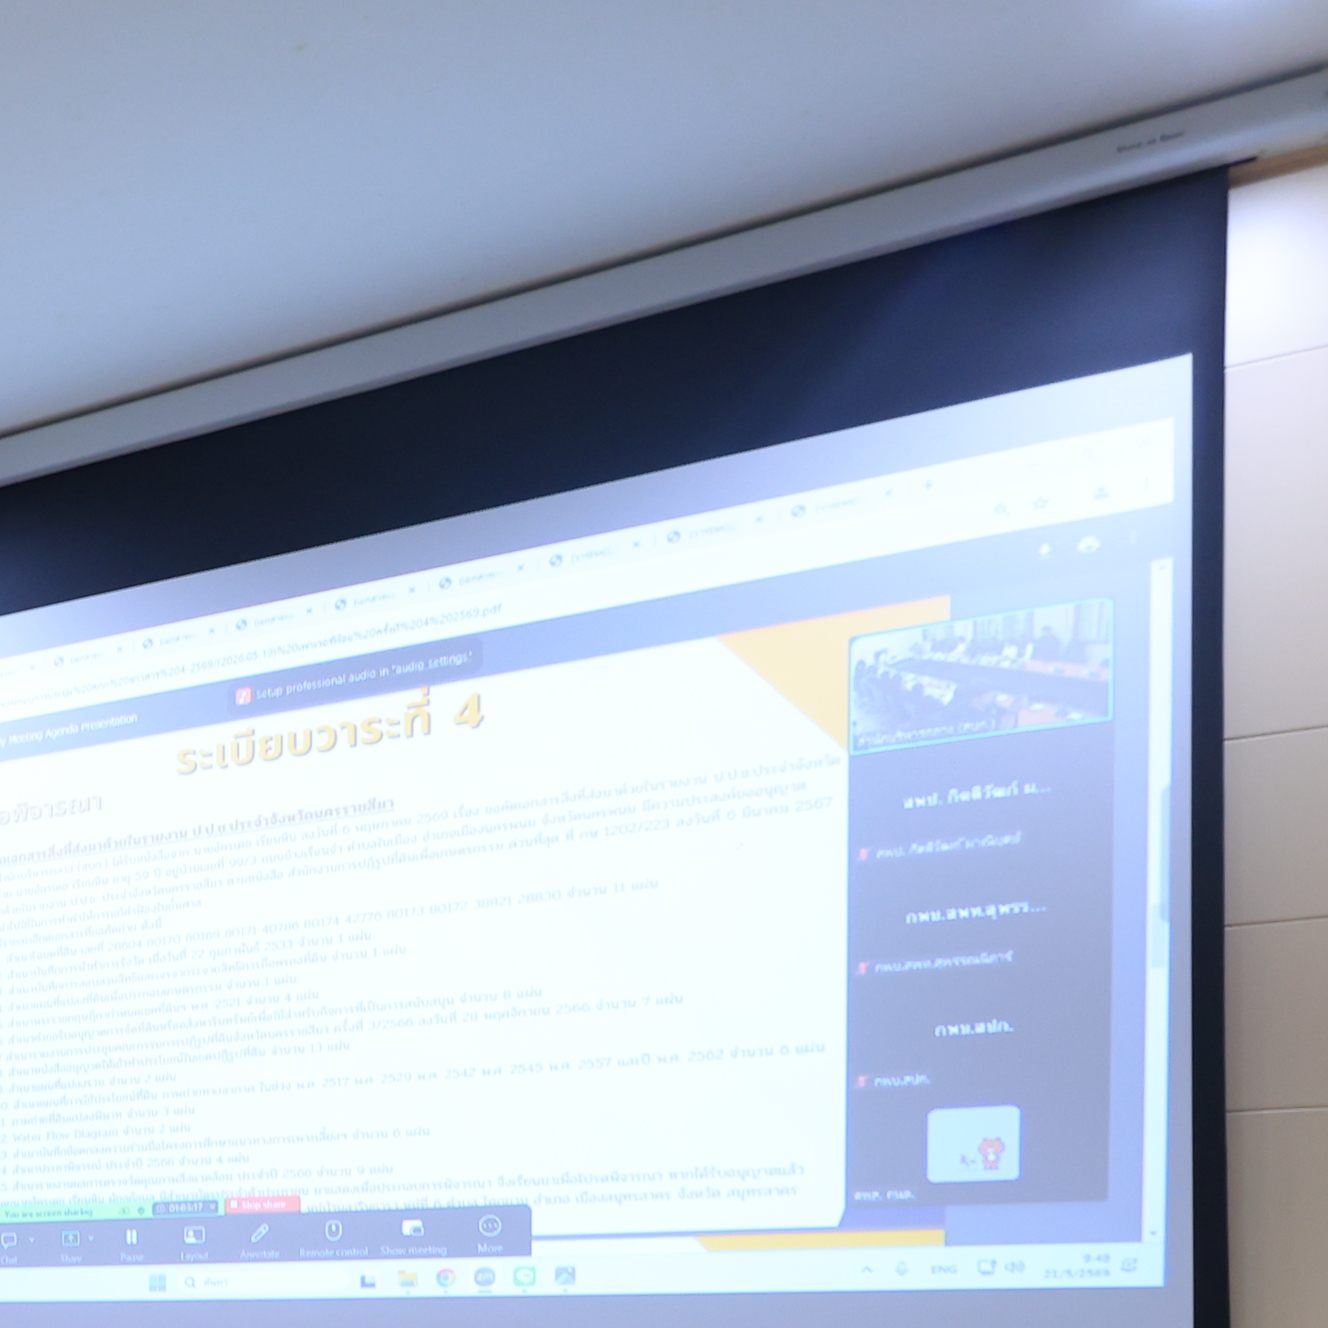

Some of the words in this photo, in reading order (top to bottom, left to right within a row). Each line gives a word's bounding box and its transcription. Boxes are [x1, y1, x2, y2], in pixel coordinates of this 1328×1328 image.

[286, 672, 346, 696] professional
[348, 666, 376, 683] audio
[379, 664, 389, 677] in
[8, 729, 42, 748] Meeting
[45, 722, 78, 741] Agenda
[80, 711, 137, 733] Presentation
[176, 684, 431, 777] ระเบียบวาระที่
[453, 690, 484, 732] 4
[11, 1132, 42, 1144] Water
[45, 1130, 70, 1142] Flow
[73, 1127, 119, 1142] Diagram
[3, 1210, 20, 1220] You
[20, 1212, 33, 1220] are
[34, 1210, 63, 1219] screen
[63, 1207, 93, 1219] sharing
[299, 1247, 333, 1258] Remote
[334, 1246, 369, 1257] control
[379, 1245, 406, 1256] Show
[407, 1244, 448, 1259] meeting
[477, 1242, 503, 1254] More
